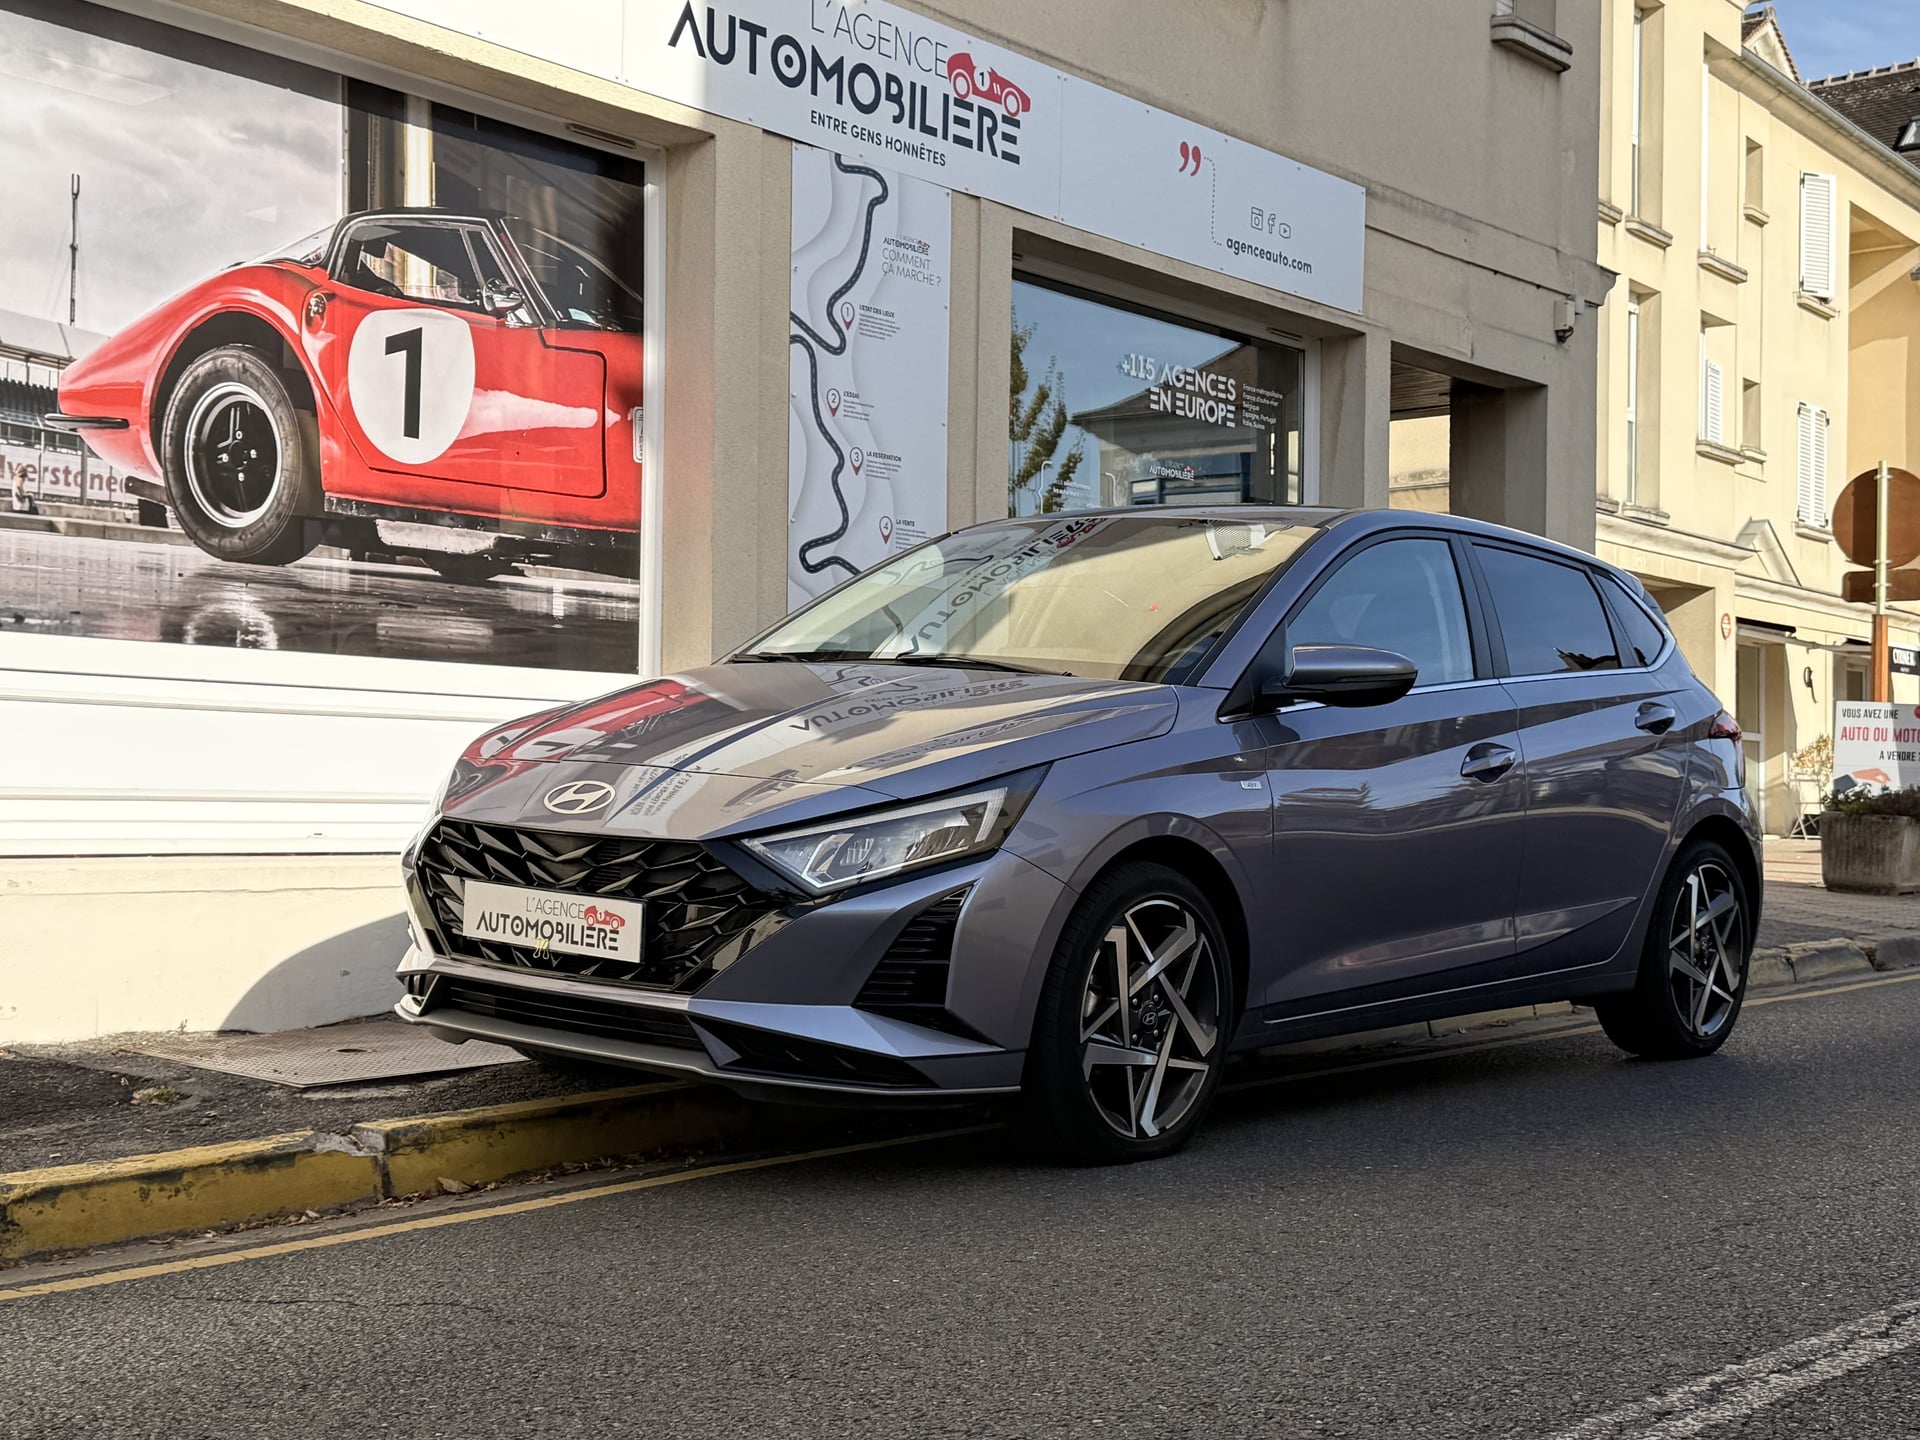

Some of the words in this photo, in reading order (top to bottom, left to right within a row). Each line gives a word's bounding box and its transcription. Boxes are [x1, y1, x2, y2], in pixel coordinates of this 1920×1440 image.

[811, 0, 948, 79] L'AGENCE
[811, 110, 848, 136] ENTRE
[851, 126, 882, 147] GENS
[886, 137, 946, 167] HONNÊTES
[883, 248, 930, 270] COMMENT
[1226, 236, 1313, 275] agenceauto.com
[882, 262, 895, 276] ÇA
[896, 265, 934, 286] MARCHE
[936, 276, 942, 287] ?
[385, 327, 423, 439] 1
[1122, 353, 1155, 380] +115
[1160, 362, 1237, 401] AGENCES
[1150, 386, 1172, 414] EN
[1176, 391, 1237, 428] EUROPE
[1842, 708, 1861, 719] VOUS
[1863, 709, 1882, 719] AVEZ
[1884, 709, 1899, 720] UNE
[1841, 726, 1869, 741] AUTO
[1873, 727, 1888, 742] OU
[1887, 751, 1916, 762] VENDRE
[526, 896, 584, 920] L'AGENCE
